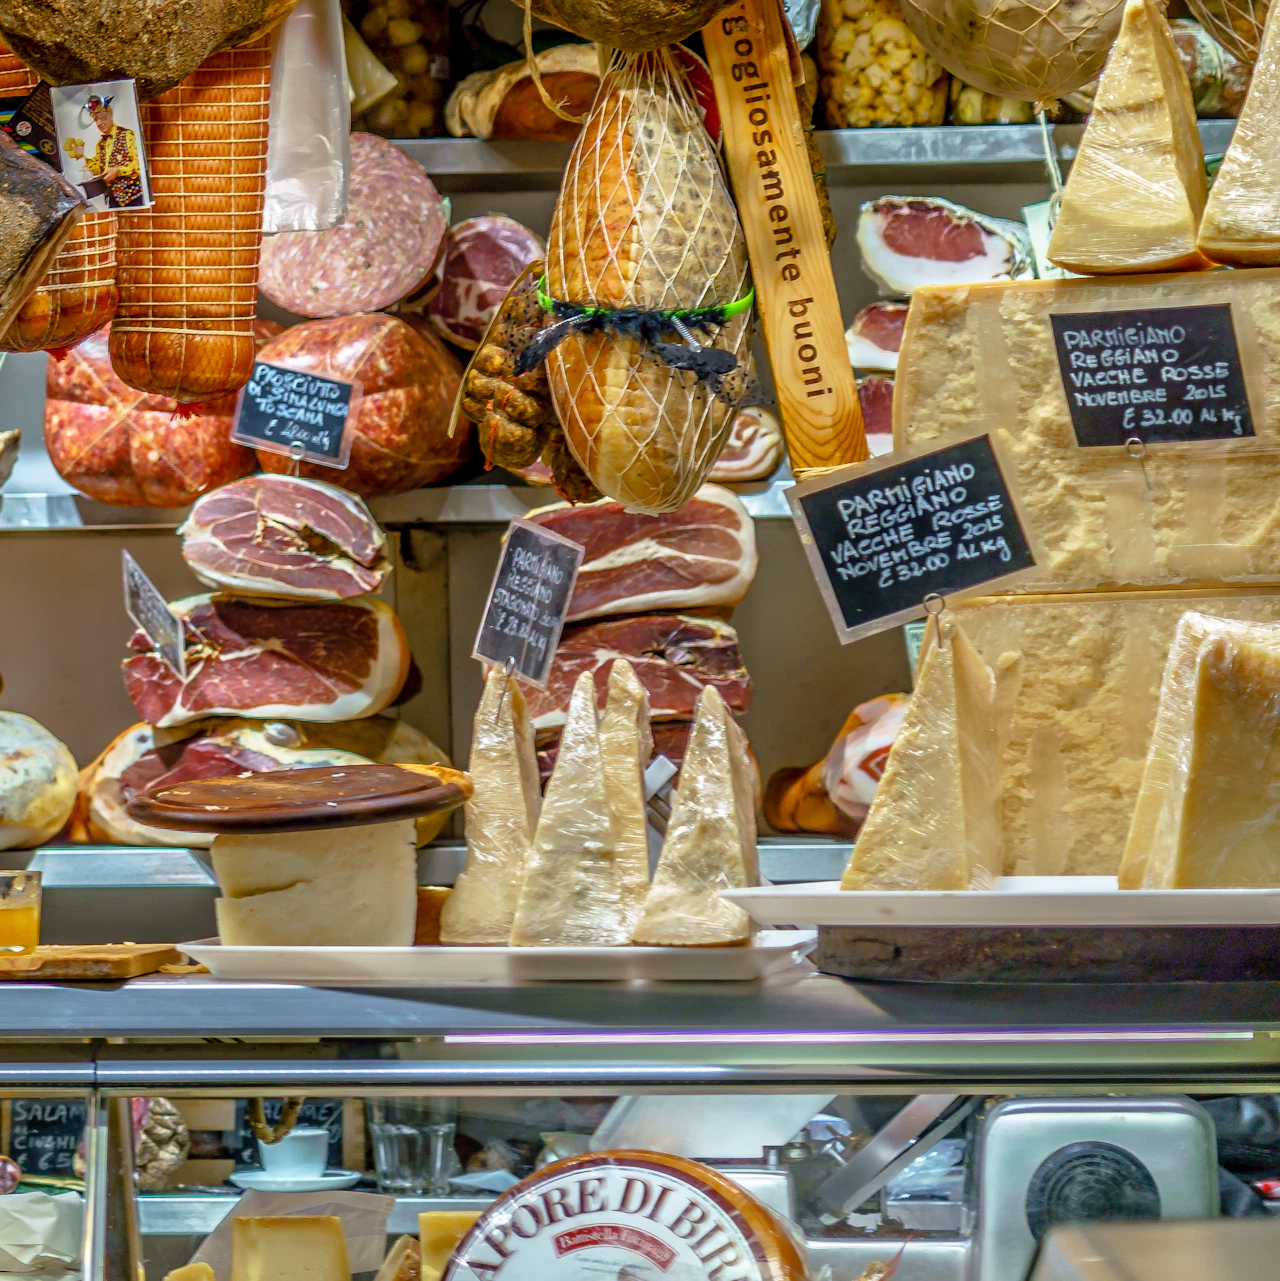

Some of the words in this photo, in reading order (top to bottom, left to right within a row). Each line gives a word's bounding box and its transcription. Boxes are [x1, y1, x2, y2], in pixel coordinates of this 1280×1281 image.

[787, 297, 833, 399] buoni
[254, 364, 341, 400] PROSCIUTTO
[1069, 367, 1149, 388] VACCHE
[1160, 361, 1230, 382] ROSSE
[1073, 387, 1168, 407] NOVEMBRE
[1182, 383, 1228, 401] 2015
[1122, 407, 1136, 429] €
[1140, 407, 1194, 427] 32.00
[1199, 407, 1218, 423] AL
[829, 523, 916, 565] VACCHE
[931, 494, 1005, 532] ROSSE
[835, 531, 953, 581] NOVEMBRE
[960, 514, 1006, 540] 2015
[878, 569, 894, 589] €
[896, 552, 951, 582] 32.00
[956, 543, 981, 561] AL
[981, 536, 1013, 563] Kg
[13, 1101, 87, 1121] SALAM
[611, 1176, 674, 1223] DI
[664, 1197, 750, 1281] BIR
